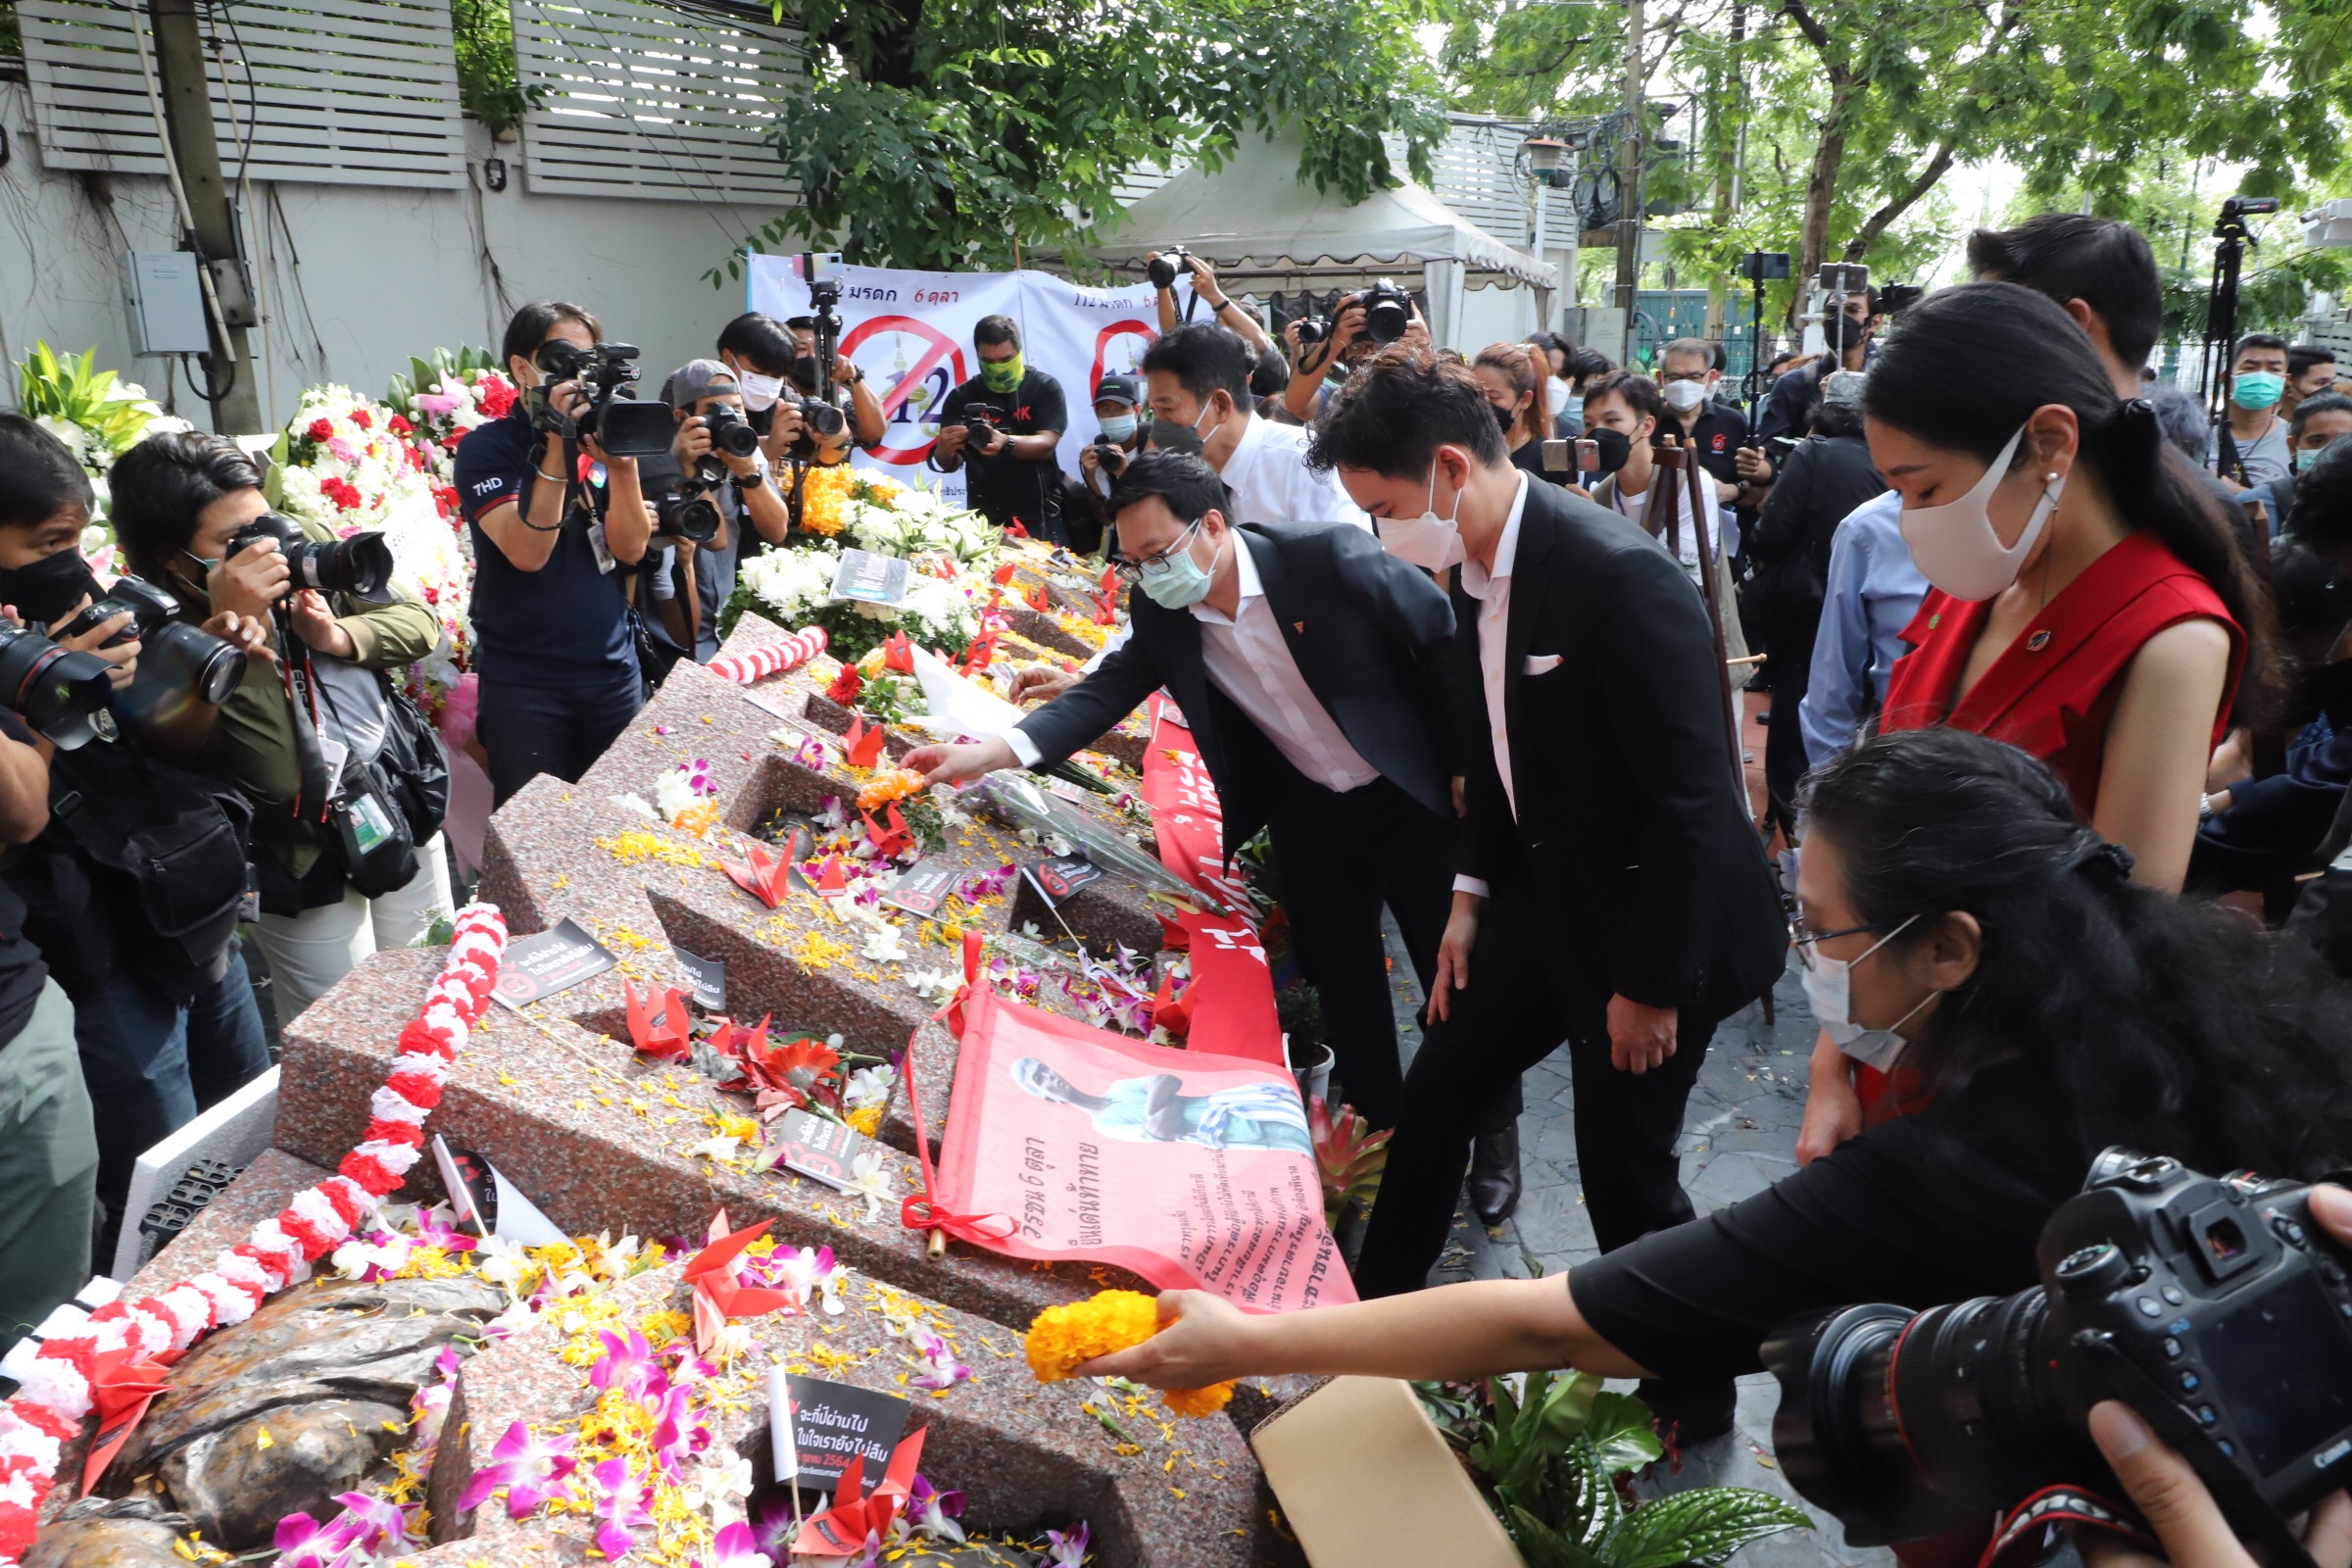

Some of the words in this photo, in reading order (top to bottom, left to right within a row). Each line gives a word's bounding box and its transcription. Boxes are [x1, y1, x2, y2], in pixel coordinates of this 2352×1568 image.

[849, 286, 898, 302] มรดก
[914, 289, 925, 303] 6
[928, 291, 959, 305] ตุลา
[1074, 293, 1096, 308] 112
[1144, 295, 1152, 307] 6
[472, 477, 503, 497] 7HD
[1024, 1137, 1056, 1172] ตุลา
[1018, 1173, 1045, 1187] 6
[1065, 1142, 1102, 1247] ยืนเด่นท้าทาย
[800, 1403, 869, 1433] จะกี่ปีผ่านไป
[797, 1427, 888, 1462] ในใจเรายังไม่ลืม
[823, 1453, 851, 1468] 2564
